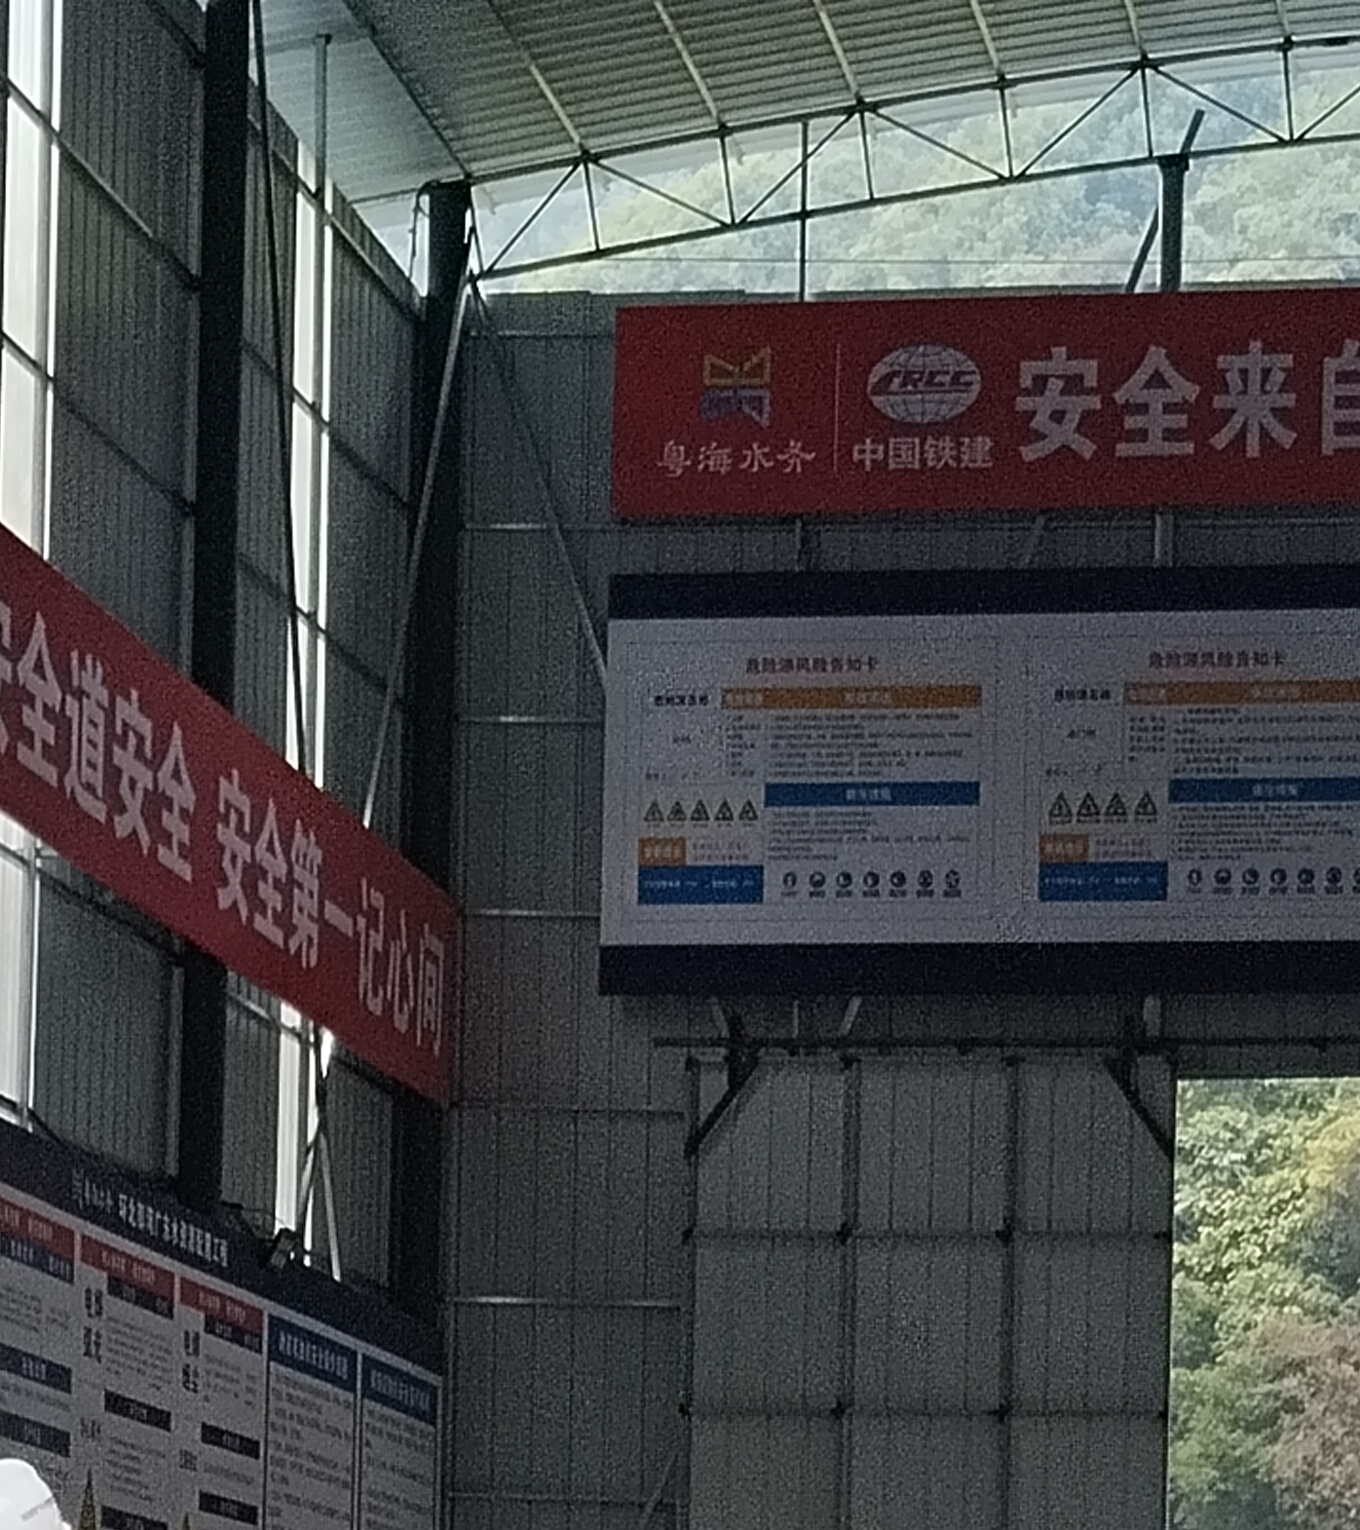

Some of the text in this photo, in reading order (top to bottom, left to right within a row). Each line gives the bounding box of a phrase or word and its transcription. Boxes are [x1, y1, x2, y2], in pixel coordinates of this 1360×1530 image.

[852, 435, 993, 473] 中国铁建
[216, 768, 444, 1056] 安全第一记心间
